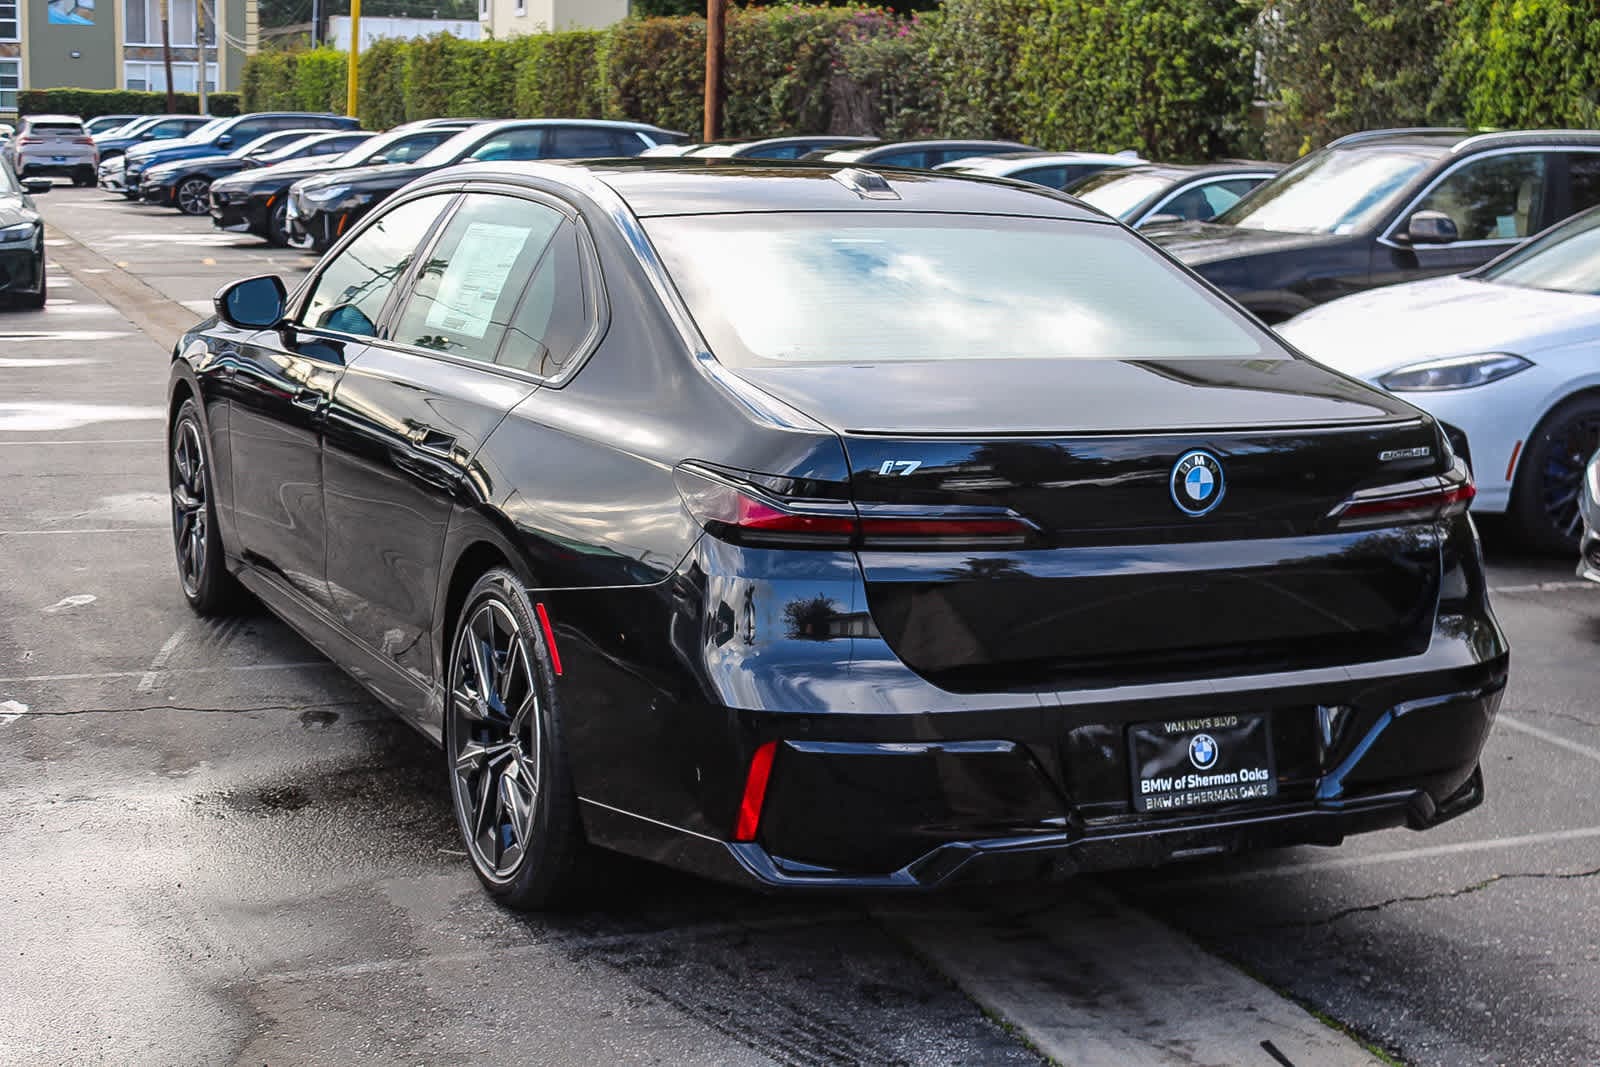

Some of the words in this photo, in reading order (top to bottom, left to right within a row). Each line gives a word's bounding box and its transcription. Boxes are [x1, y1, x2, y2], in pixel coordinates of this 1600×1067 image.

[879, 460, 922, 476] i7
[1164, 721, 1185, 733] VAN
[1186, 718, 1212, 730] NUYS
[1213, 716, 1238, 728] BLVD
[1141, 777, 1172, 793] BMW
[1174, 775, 1186, 789] of
[1187, 773, 1238, 788] Sherman
[1239, 768, 1269, 781] Oaks
[1146, 797, 1172, 810] BMW
[1174, 794, 1184, 806] of
[1186, 788, 1239, 804] SHERMAN
[1239, 784, 1268, 799] OAKS
